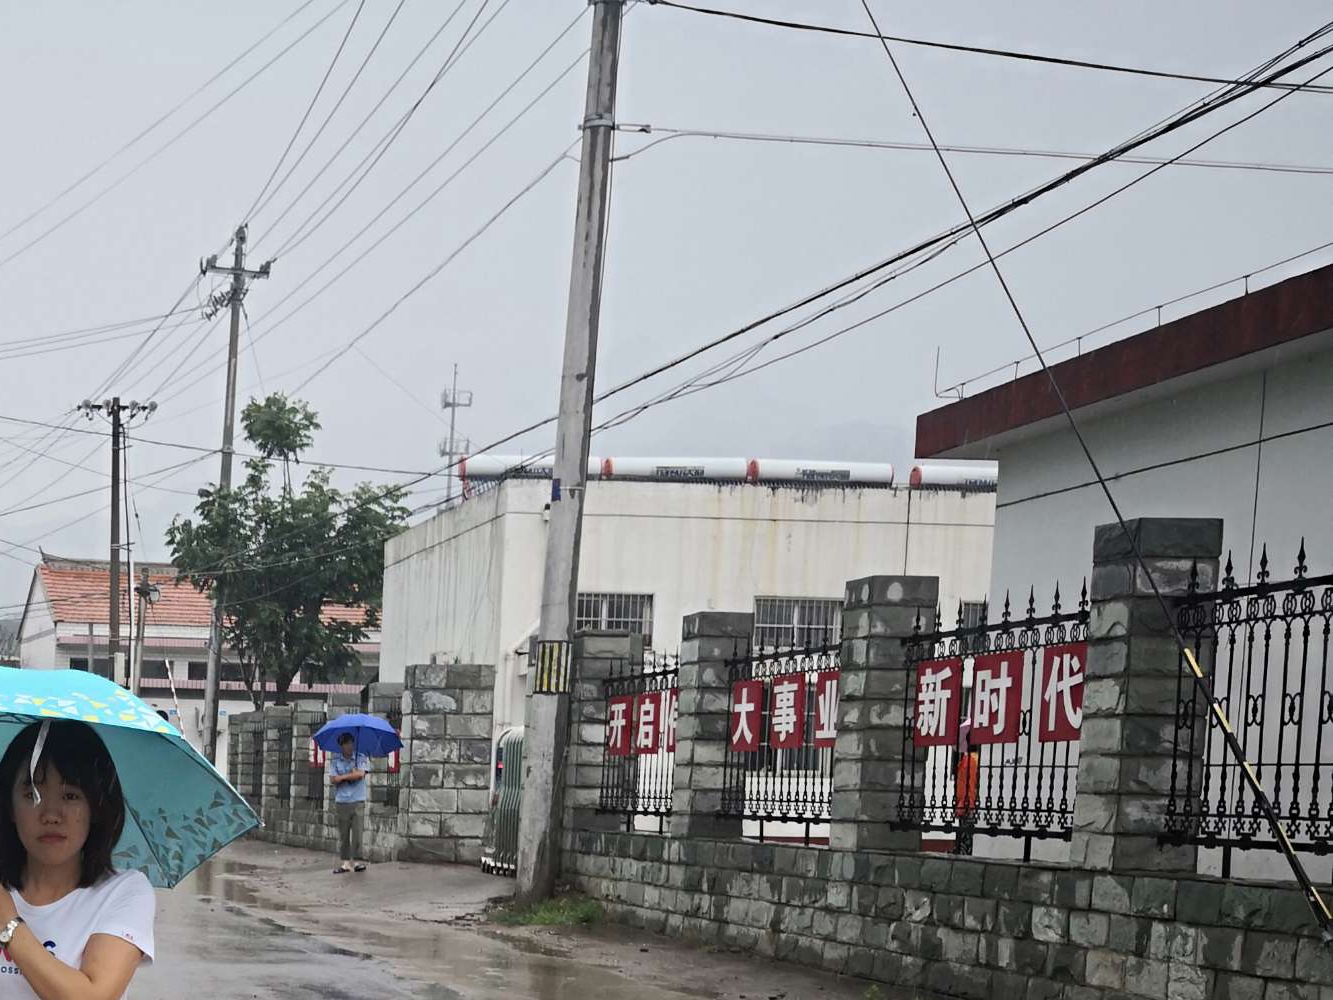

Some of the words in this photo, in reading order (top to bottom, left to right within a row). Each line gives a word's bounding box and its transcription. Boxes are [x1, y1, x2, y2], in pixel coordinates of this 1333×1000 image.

[732, 679, 841, 745] 大事业
[916, 653, 1083, 737] 新时代
